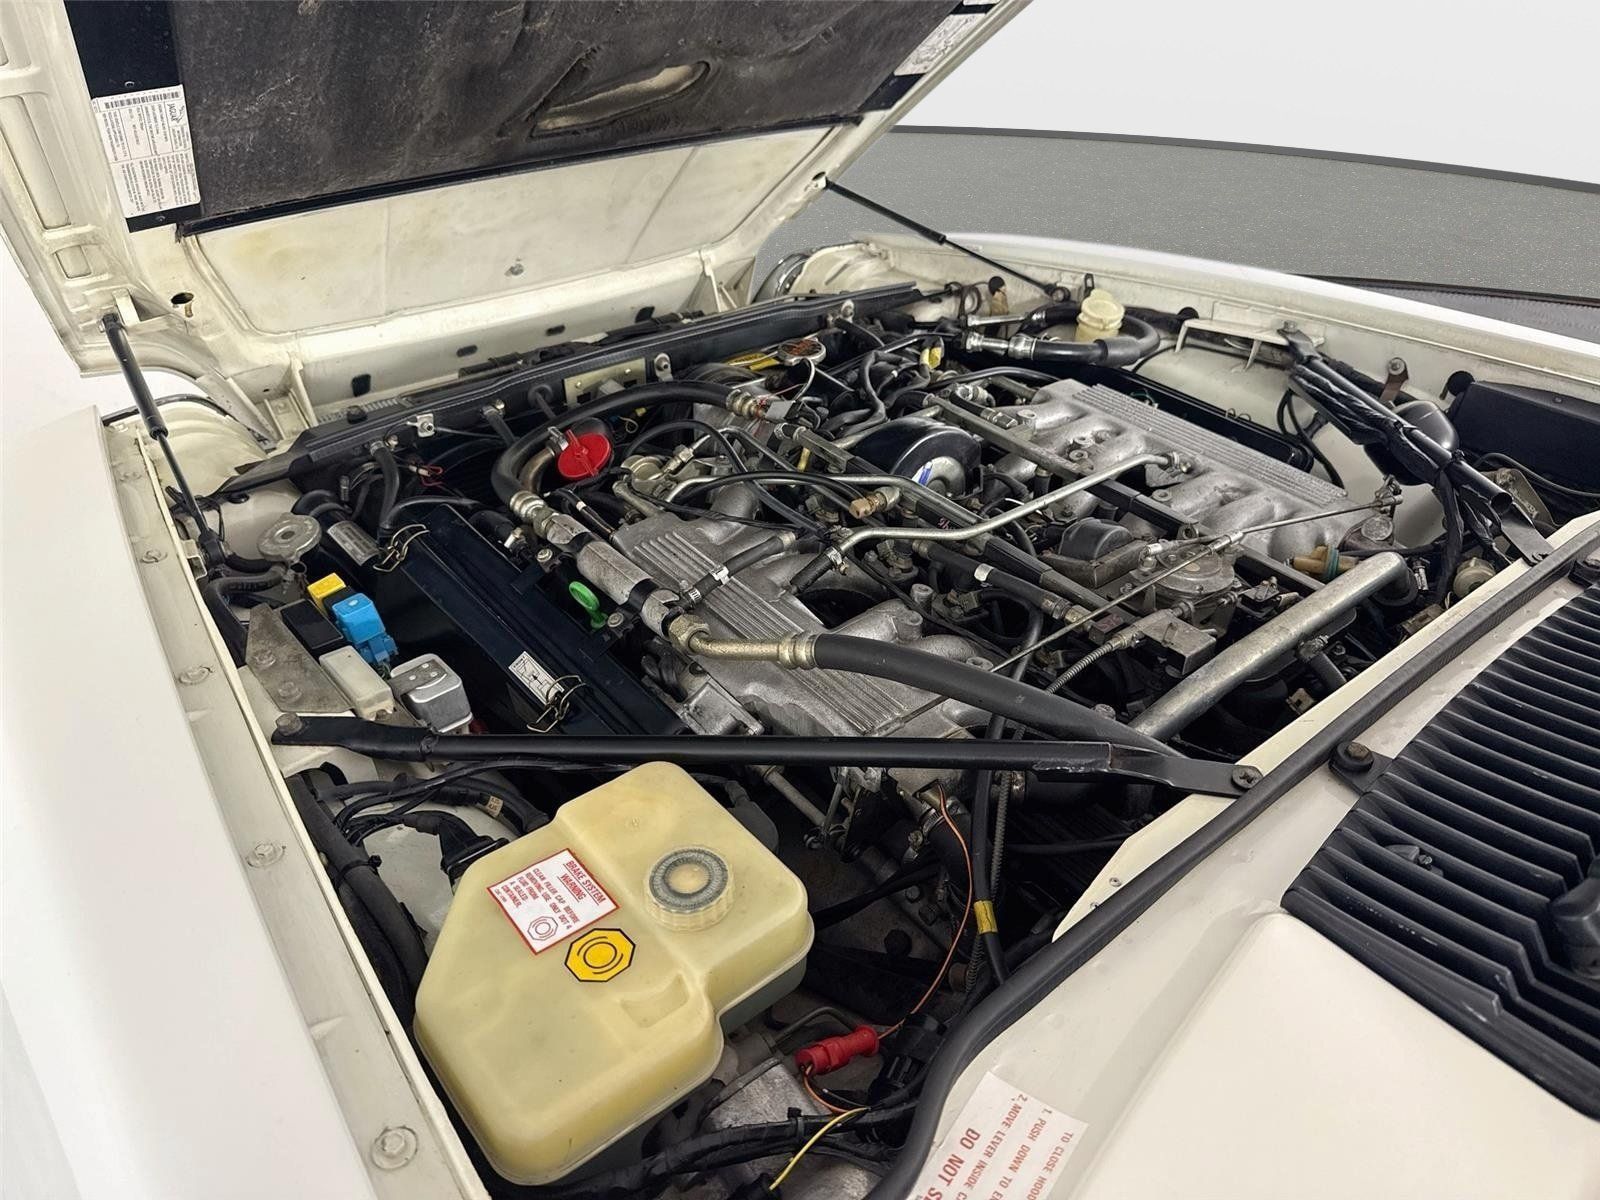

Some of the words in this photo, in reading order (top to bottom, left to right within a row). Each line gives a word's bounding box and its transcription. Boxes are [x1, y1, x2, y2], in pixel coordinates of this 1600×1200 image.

[513, 884, 529, 902] SEALED
[526, 886, 539, 900] FROM
[560, 873, 586, 900] WARNING
[566, 860, 583, 880] BRAKE
[582, 879, 607, 903] SYSTEM
[533, 868, 546, 881] CLEAN
[544, 881, 558, 895] FILLER
[555, 894, 566, 905] CAP
[563, 905, 580, 923] BEFORE
[541, 892, 552, 902] USE
[549, 902, 561, 914] ONLY
[559, 914, 570, 925] DOT
[1002, 1103, 1023, 1129] MOVE
[1027, 1117, 1047, 1142] PUSH
[959, 1127, 981, 1150] DO
[983, 1130, 1007, 1159] LEVER
[1060, 1131, 1074, 1144] TO
[937, 1153, 965, 1187] NOT
[1008, 1144, 1031, 1173] DOWN
[1042, 1145, 1065, 1174] CLOSE
[963, 1159, 988, 1190] INSIDE
[999, 1175, 1013, 1189] TO
[1026, 1175, 1048, 1200] HOOD
